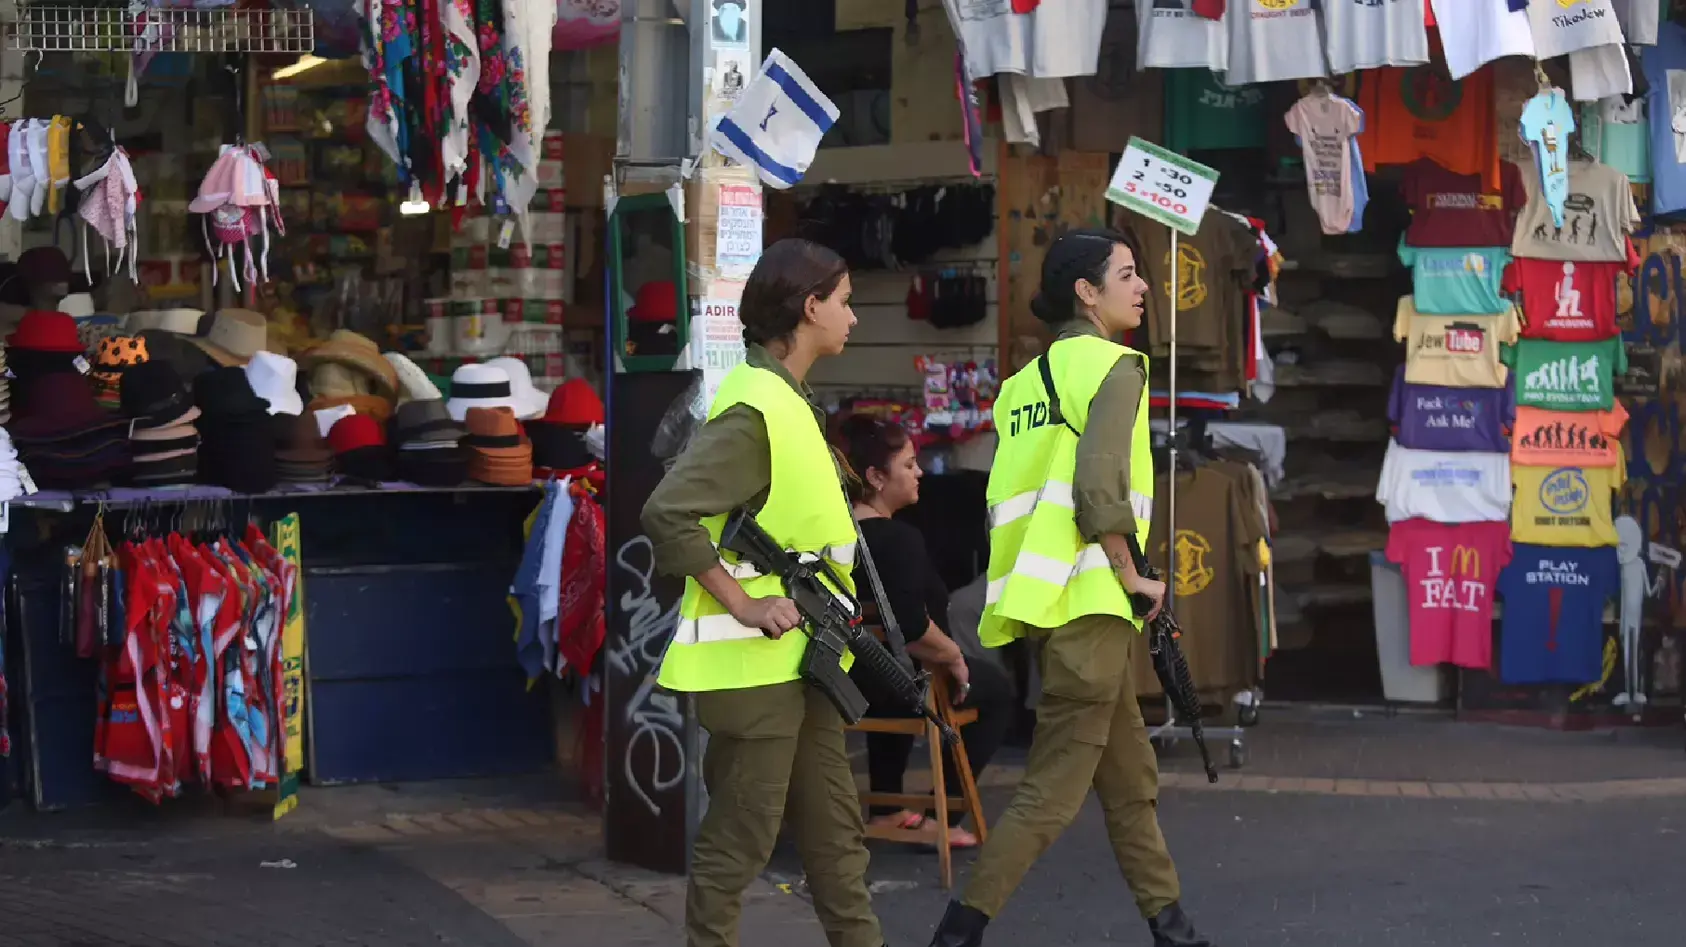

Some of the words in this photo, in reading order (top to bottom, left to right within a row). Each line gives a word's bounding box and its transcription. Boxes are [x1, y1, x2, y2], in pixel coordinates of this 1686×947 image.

[1132, 170, 1145, 181] 2
[1124, 181, 1137, 193] 5
[705, 304, 736, 317] ADIR
[1418, 332, 1444, 348] Jew
[1449, 329, 1480, 351] Tube
[1417, 397, 1443, 410] Fuck
[1011, 401, 1047, 437] טרה
[1426, 414, 1449, 428] Ask
[1452, 414, 1475, 428] Me!
[1425, 546, 1443, 576] I
[1539, 560, 1578, 571] PLAY
[1526, 572, 1590, 585] STATION
[1420, 578, 1485, 611] FAT
